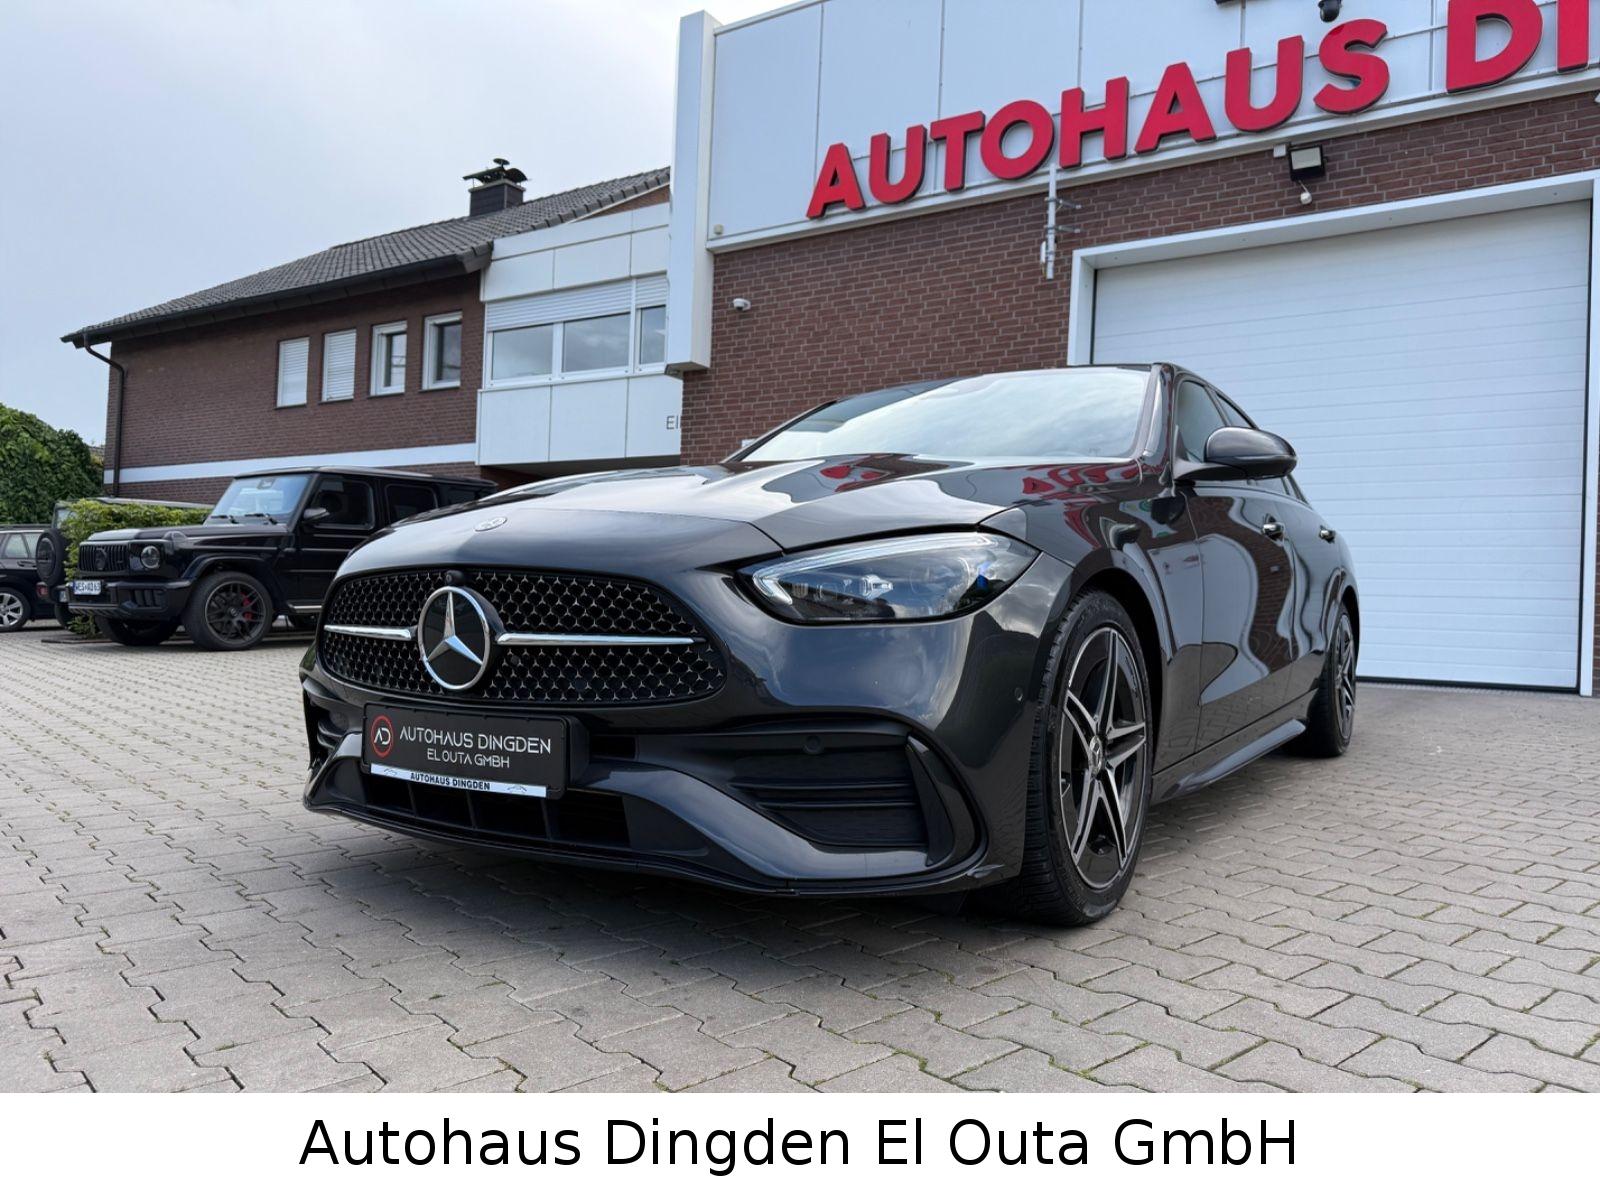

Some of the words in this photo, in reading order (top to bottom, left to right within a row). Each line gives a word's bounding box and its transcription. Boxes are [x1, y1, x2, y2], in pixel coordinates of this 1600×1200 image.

[807, 18, 1390, 218] AUTOHAUS
[666, 415, 681, 430] EI
[374, 727, 391, 745] AD
[400, 726, 473, 749] AUTOHAUS
[477, 733, 551, 755] DINGDEN
[427, 748, 441, 761] EL
[442, 750, 473, 765] OUTA
[474, 753, 510, 769] GMBH
[410, 772, 450, 786] AUTOHAUS
[452, 778, 491, 791] DINGDEN
